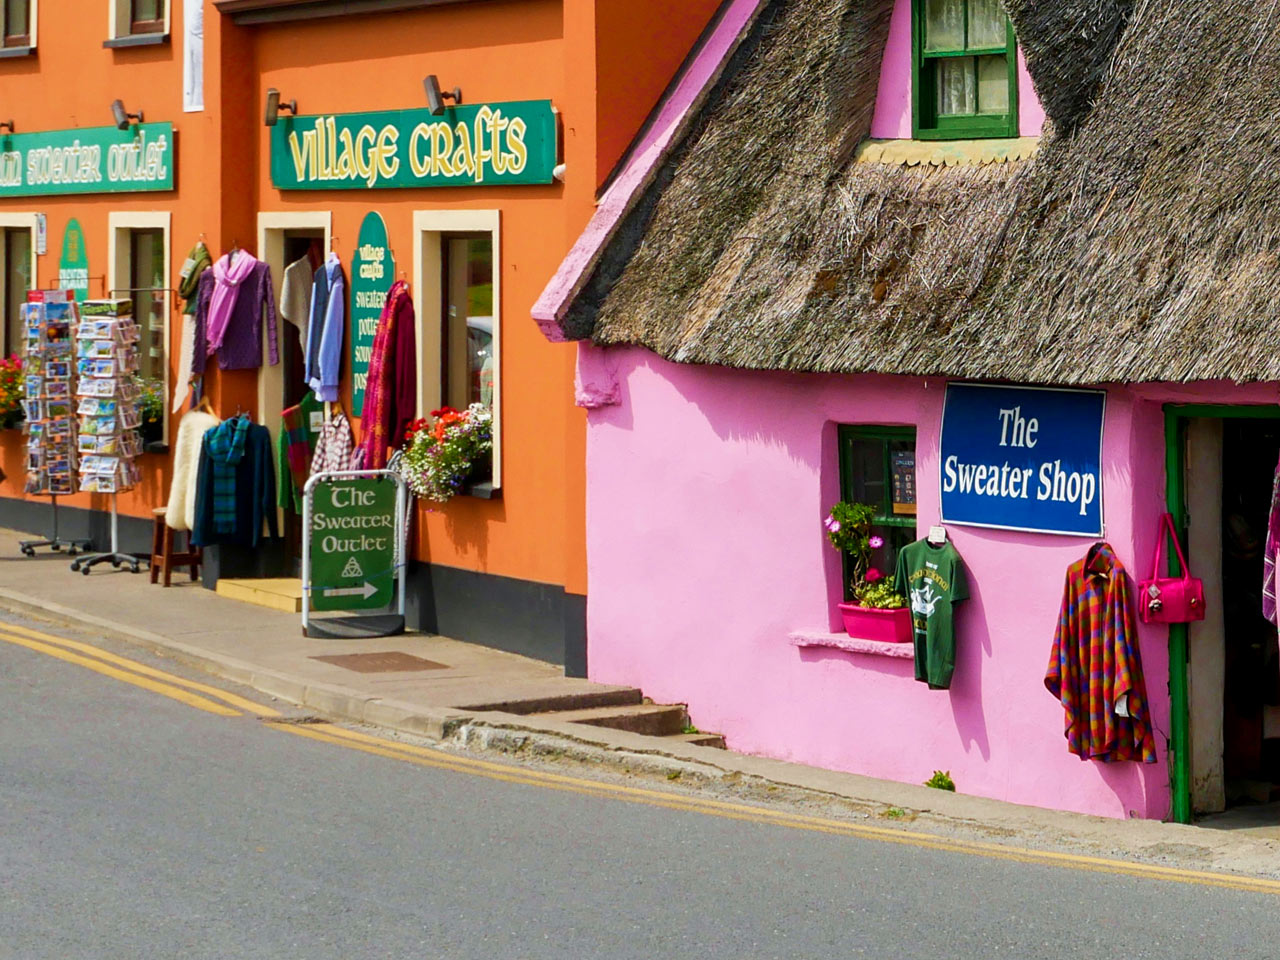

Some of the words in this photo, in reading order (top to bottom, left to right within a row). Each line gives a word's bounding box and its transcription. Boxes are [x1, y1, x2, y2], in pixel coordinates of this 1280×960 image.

[998, 406, 1039, 448] The
[943, 455, 1032, 499] Sweater
[1037, 460, 1095, 515] Shop
[330, 486, 376, 508] The
[313, 513, 393, 530] Sweater
[322, 534, 387, 553] Outlet
